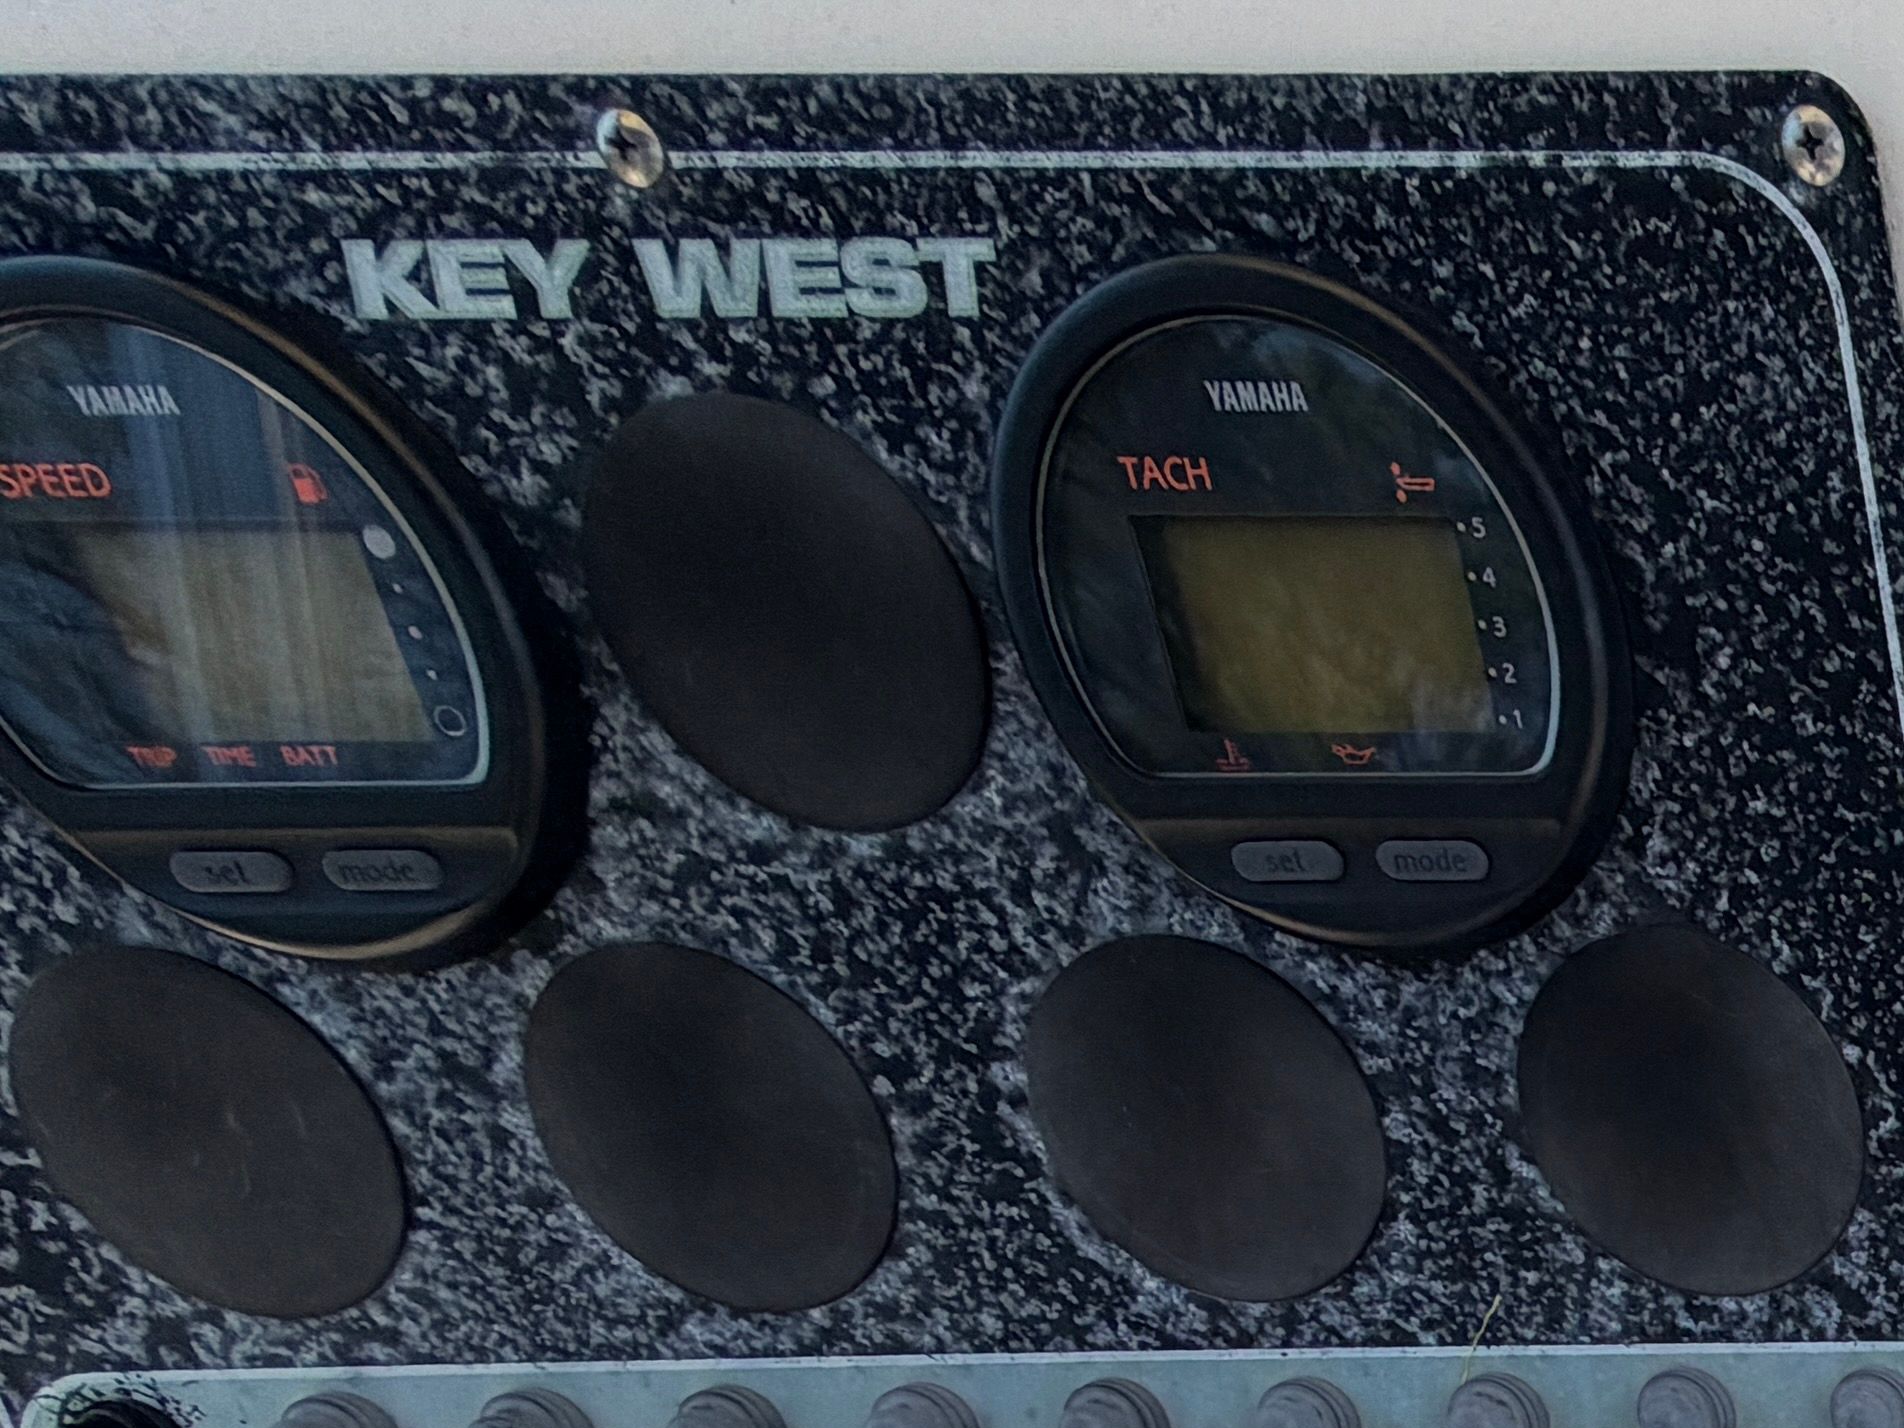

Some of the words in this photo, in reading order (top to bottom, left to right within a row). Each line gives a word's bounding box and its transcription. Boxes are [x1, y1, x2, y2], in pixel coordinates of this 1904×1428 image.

[342, 239, 590, 320] KEY
[632, 237, 996, 318] WEST
[66, 385, 181, 417] YAMAHA
[1203, 380, 1309, 413] YAMAHA
[0, 462, 113, 499] SPEED
[1117, 456, 1213, 491] TACH
[1472, 517, 1486, 539] 5
[1482, 567, 1497, 588] 4
[1493, 616, 1507, 638] 3
[1502, 663, 1517, 684] 2
[1512, 709, 1523, 729] 1
[204, 747, 256, 767] TIME
[280, 746, 338, 766] BATT
[340, 855, 414, 884] mode
[1264, 850, 1308, 873] set
[1394, 847, 1467, 873] mode
